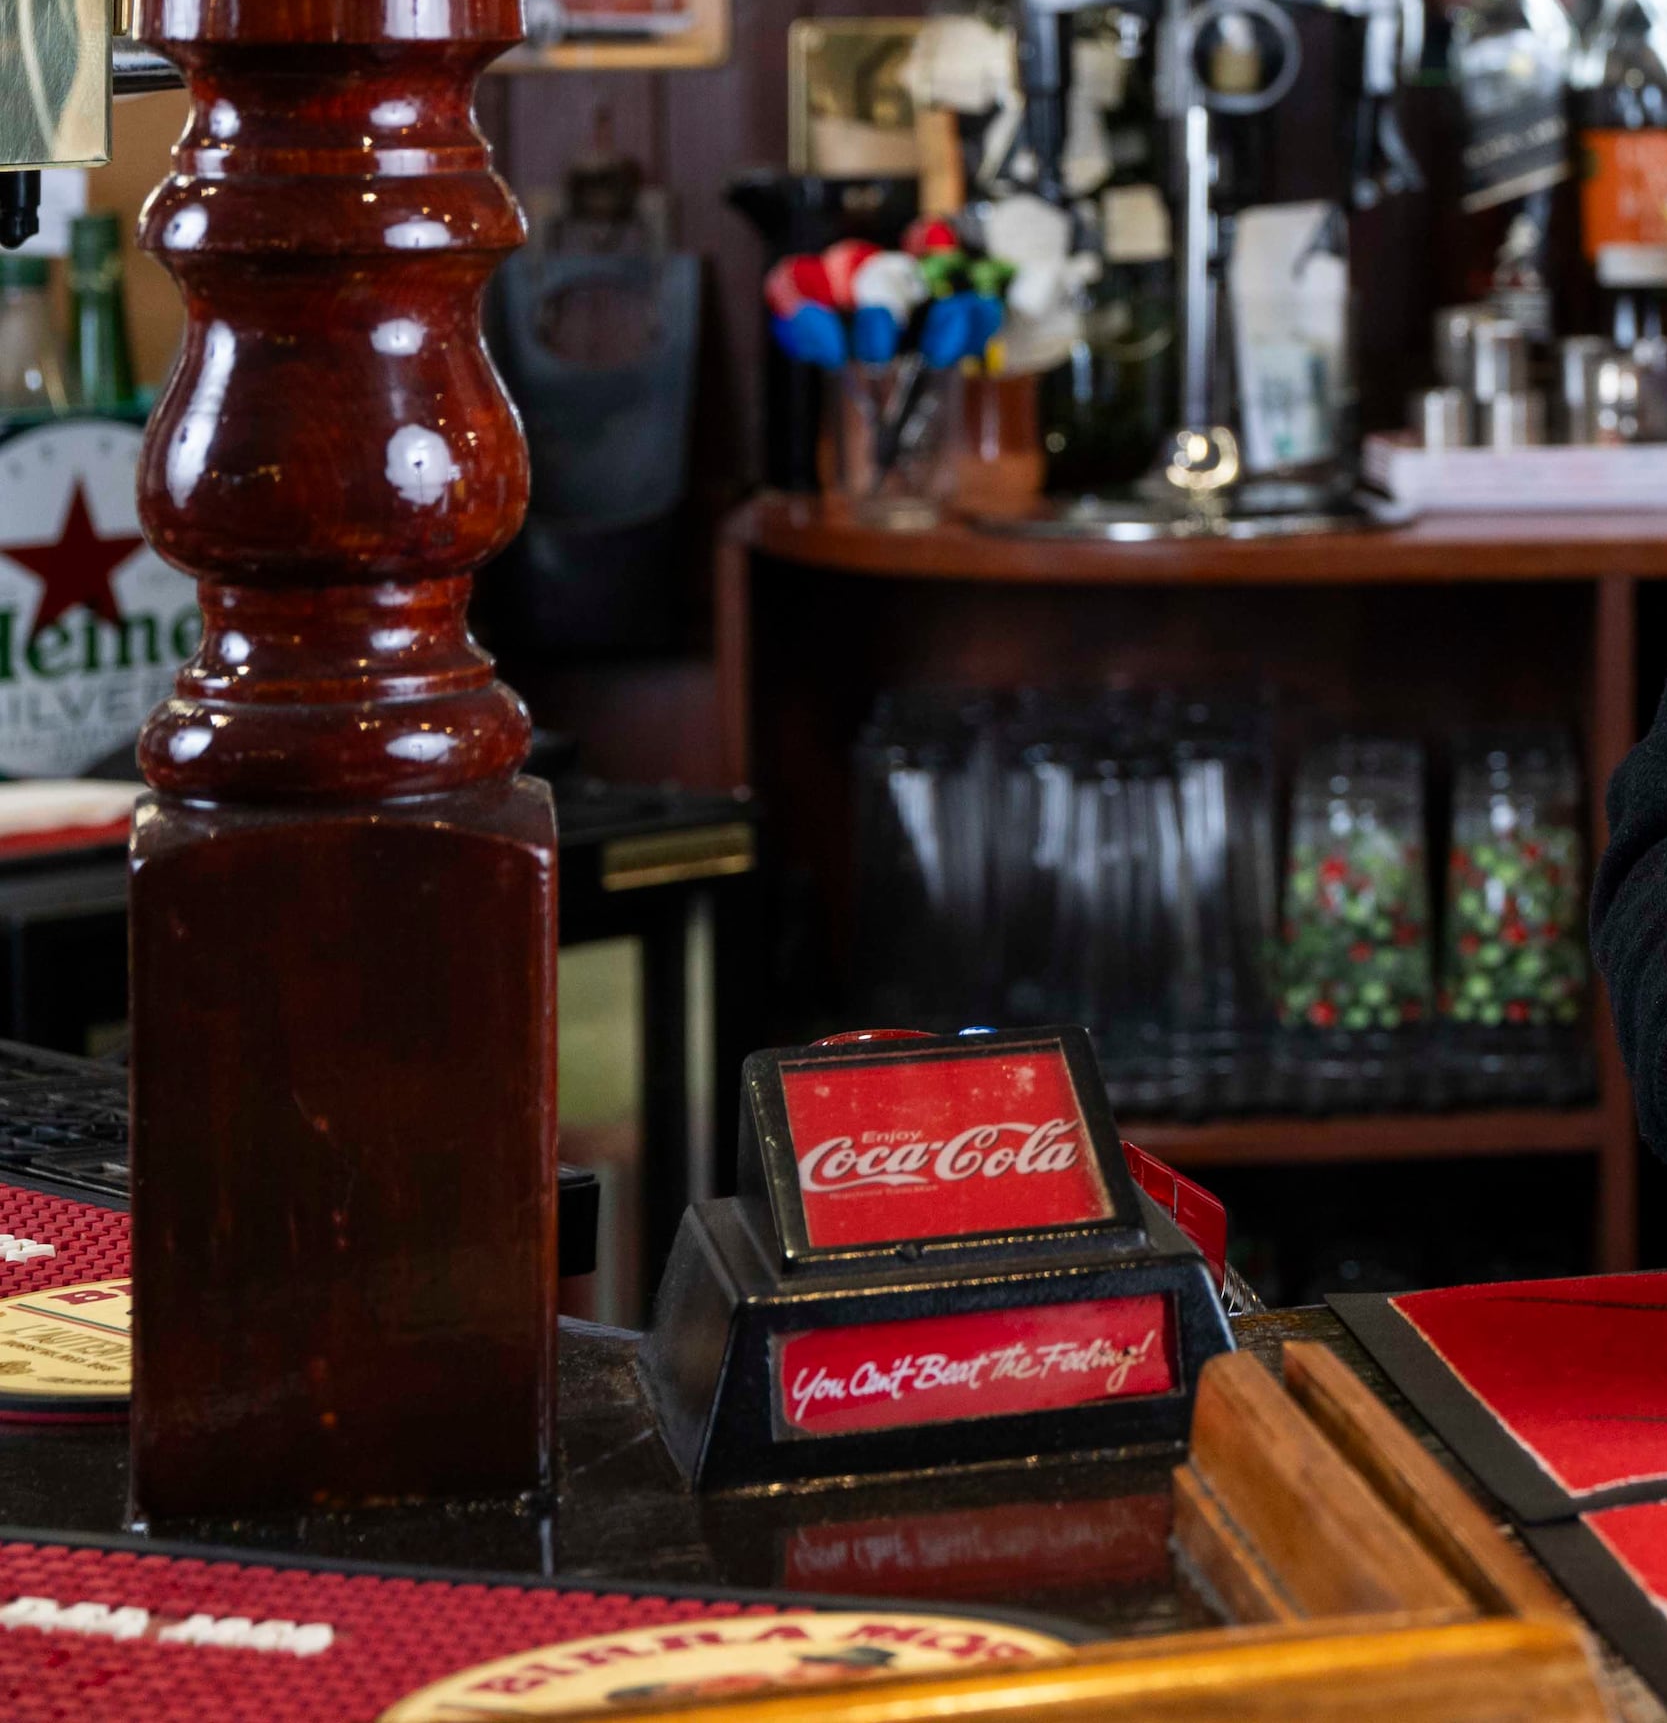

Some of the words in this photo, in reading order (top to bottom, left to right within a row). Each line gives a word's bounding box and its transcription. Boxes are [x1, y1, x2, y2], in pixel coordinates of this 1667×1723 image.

[797, 1117, 1081, 1194] Coca-Cola
[861, 1128, 925, 1146] Enjoy
[791, 1367, 847, 1422] You
[848, 1354, 915, 1401] Can't
[912, 1352, 989, 1390] Beat
[988, 1340, 1040, 1382] The
[1037, 1328, 1156, 1393] Feeling!
